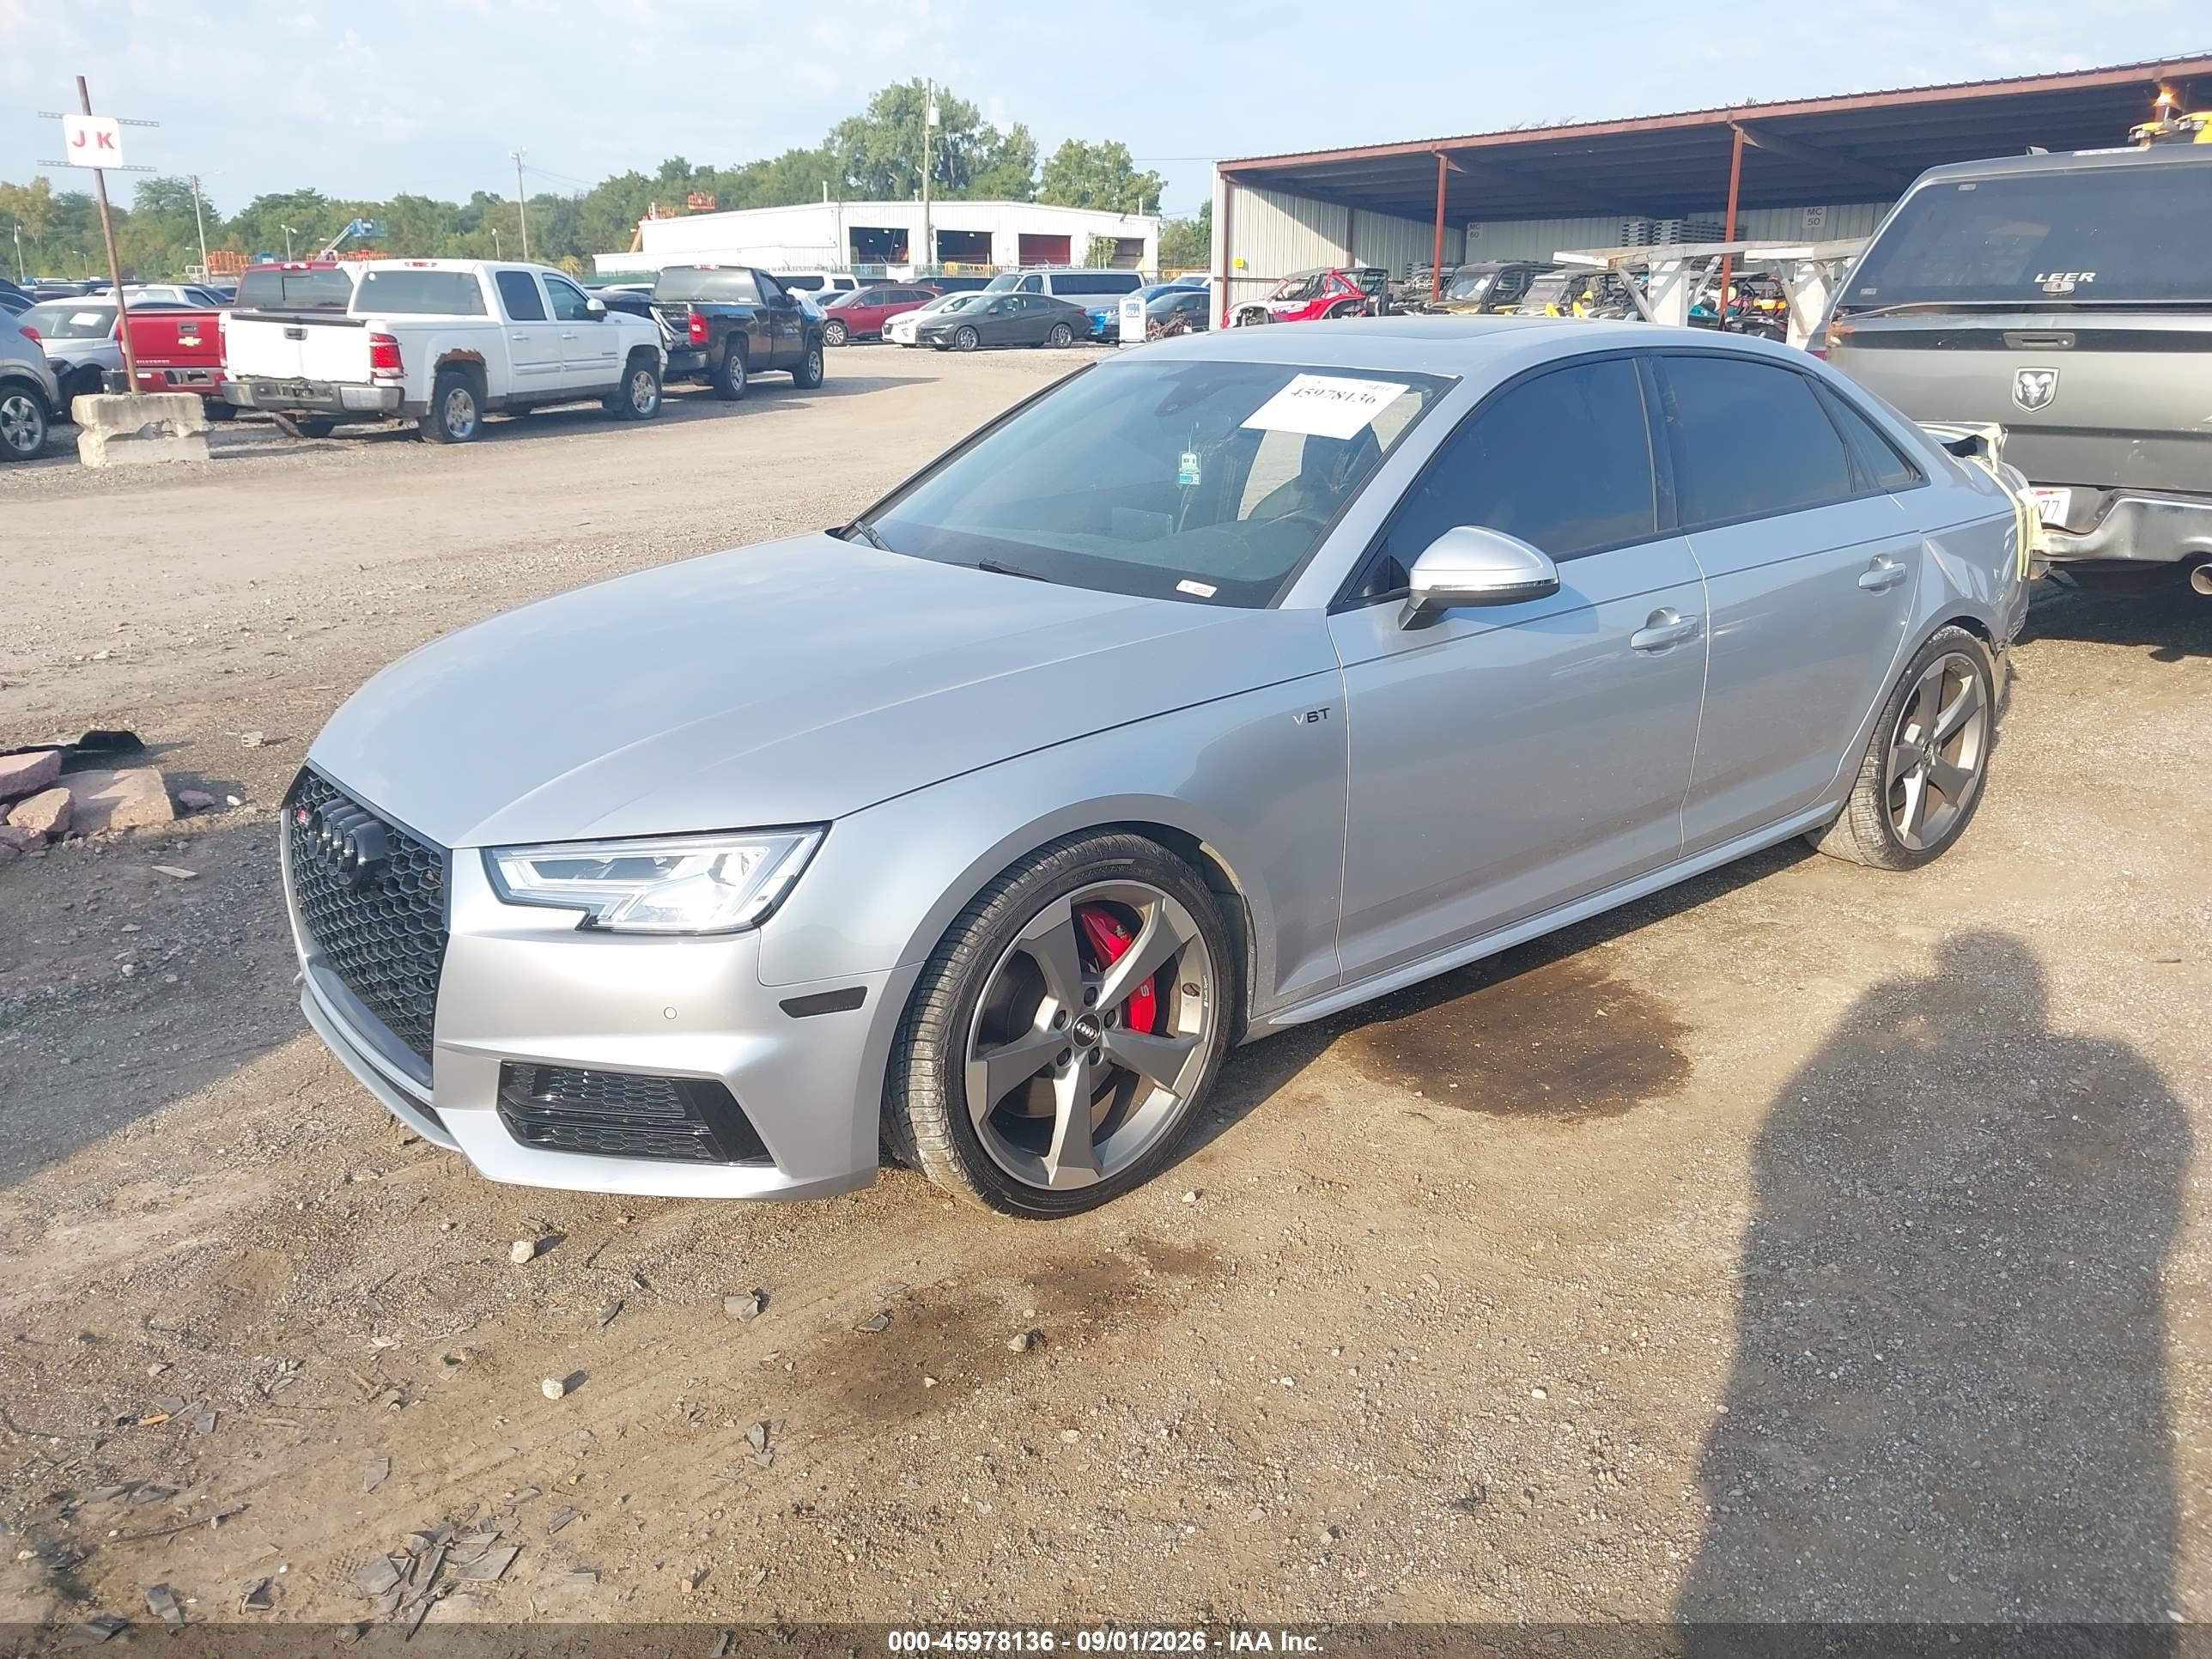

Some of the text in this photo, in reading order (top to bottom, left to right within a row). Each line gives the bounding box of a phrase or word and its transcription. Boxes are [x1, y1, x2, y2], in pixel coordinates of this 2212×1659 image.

[71, 130, 115, 149] J K
[1807, 207, 1822, 216] MC
[2033, 272, 2096, 283] LEER
[1292, 707, 1330, 726] V6T
[1139, 984, 1150, 997] S
